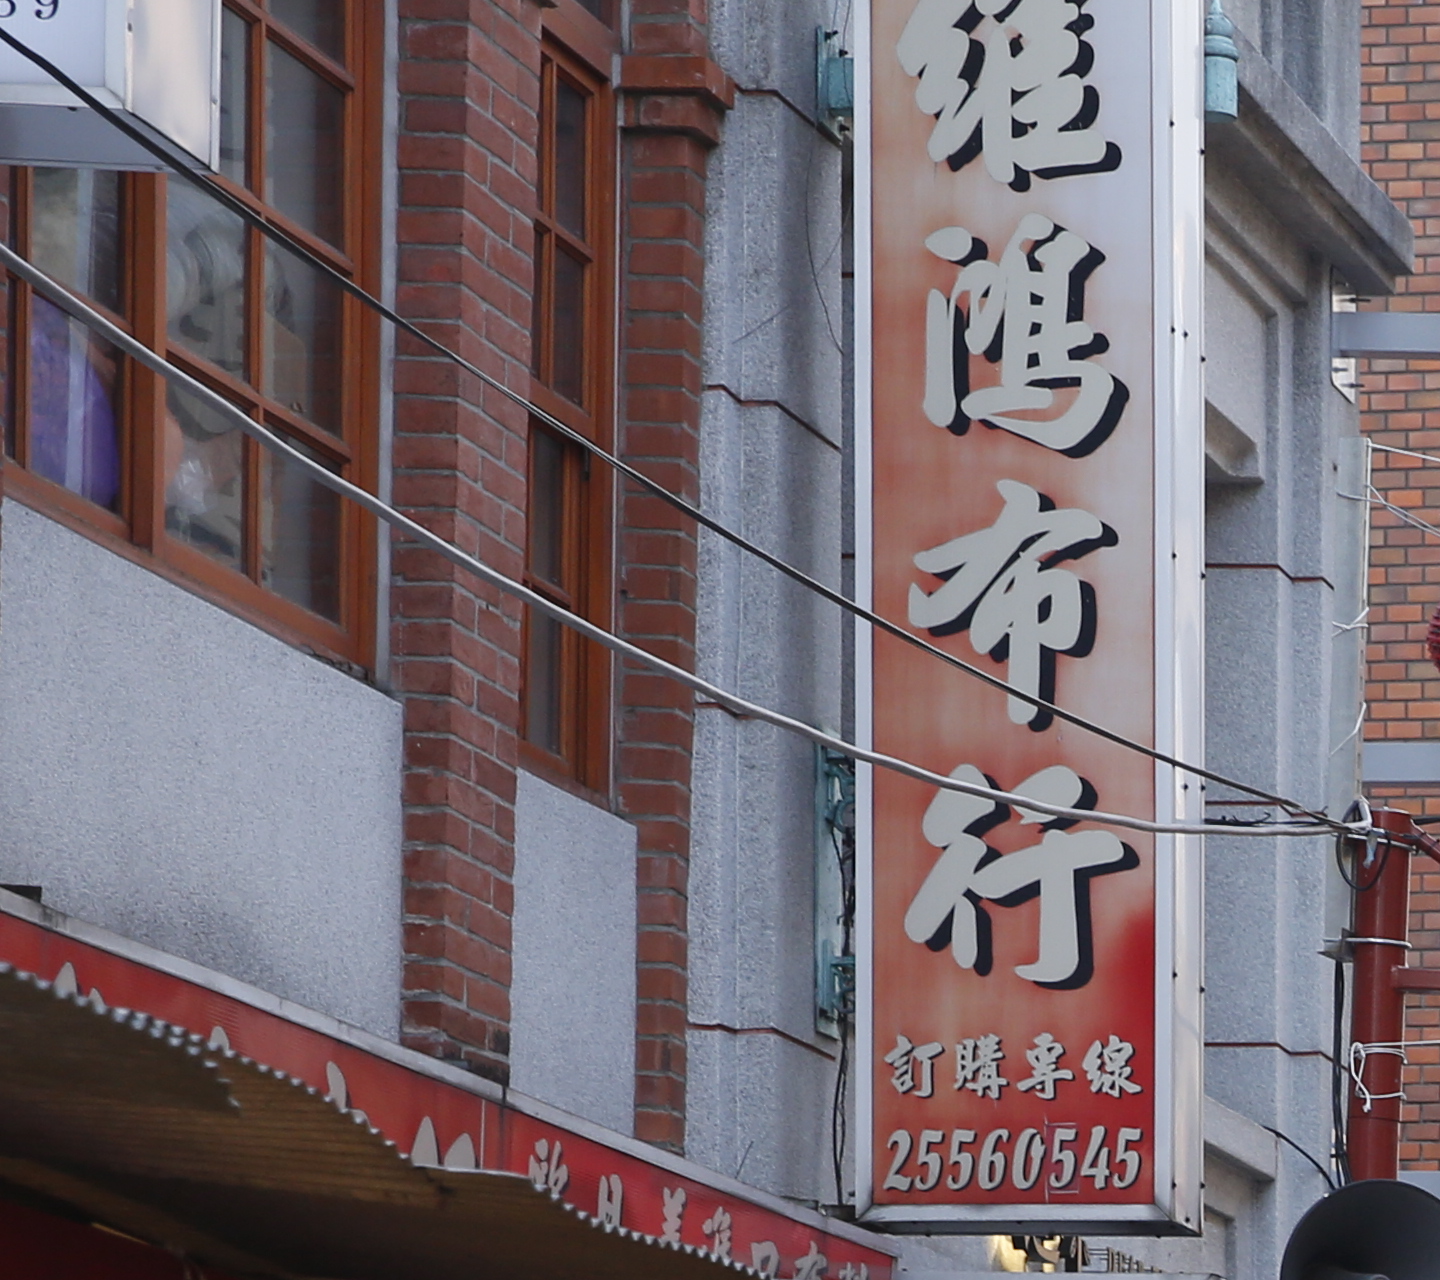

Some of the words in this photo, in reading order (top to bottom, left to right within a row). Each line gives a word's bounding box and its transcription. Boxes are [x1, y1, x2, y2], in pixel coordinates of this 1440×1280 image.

[883, 1032, 1144, 1100] 訂購專線
[882, 1124, 1143, 1193] 25560545
